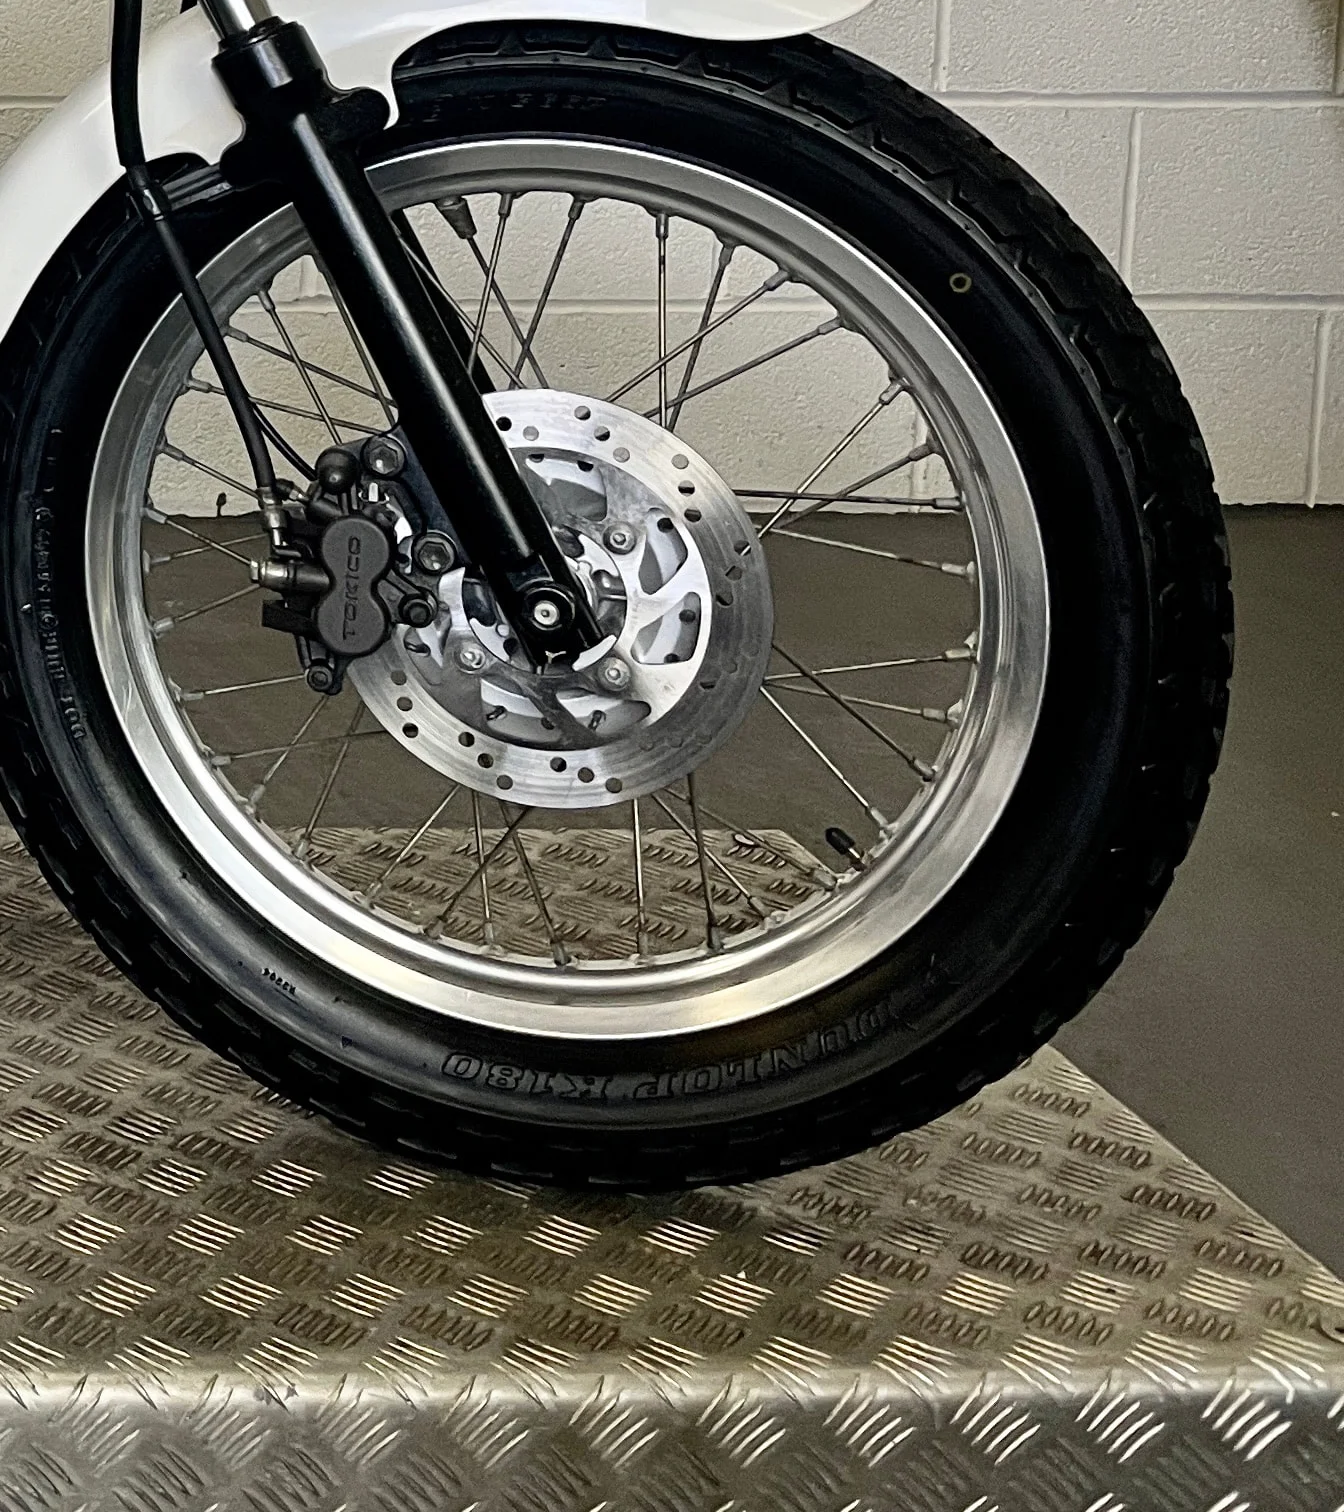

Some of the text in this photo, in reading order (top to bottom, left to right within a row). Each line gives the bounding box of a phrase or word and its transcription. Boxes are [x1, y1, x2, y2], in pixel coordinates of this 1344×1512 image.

[342, 535, 361, 641] TOKICO
[440, 1004, 889, 1101] DUNLOP K180
